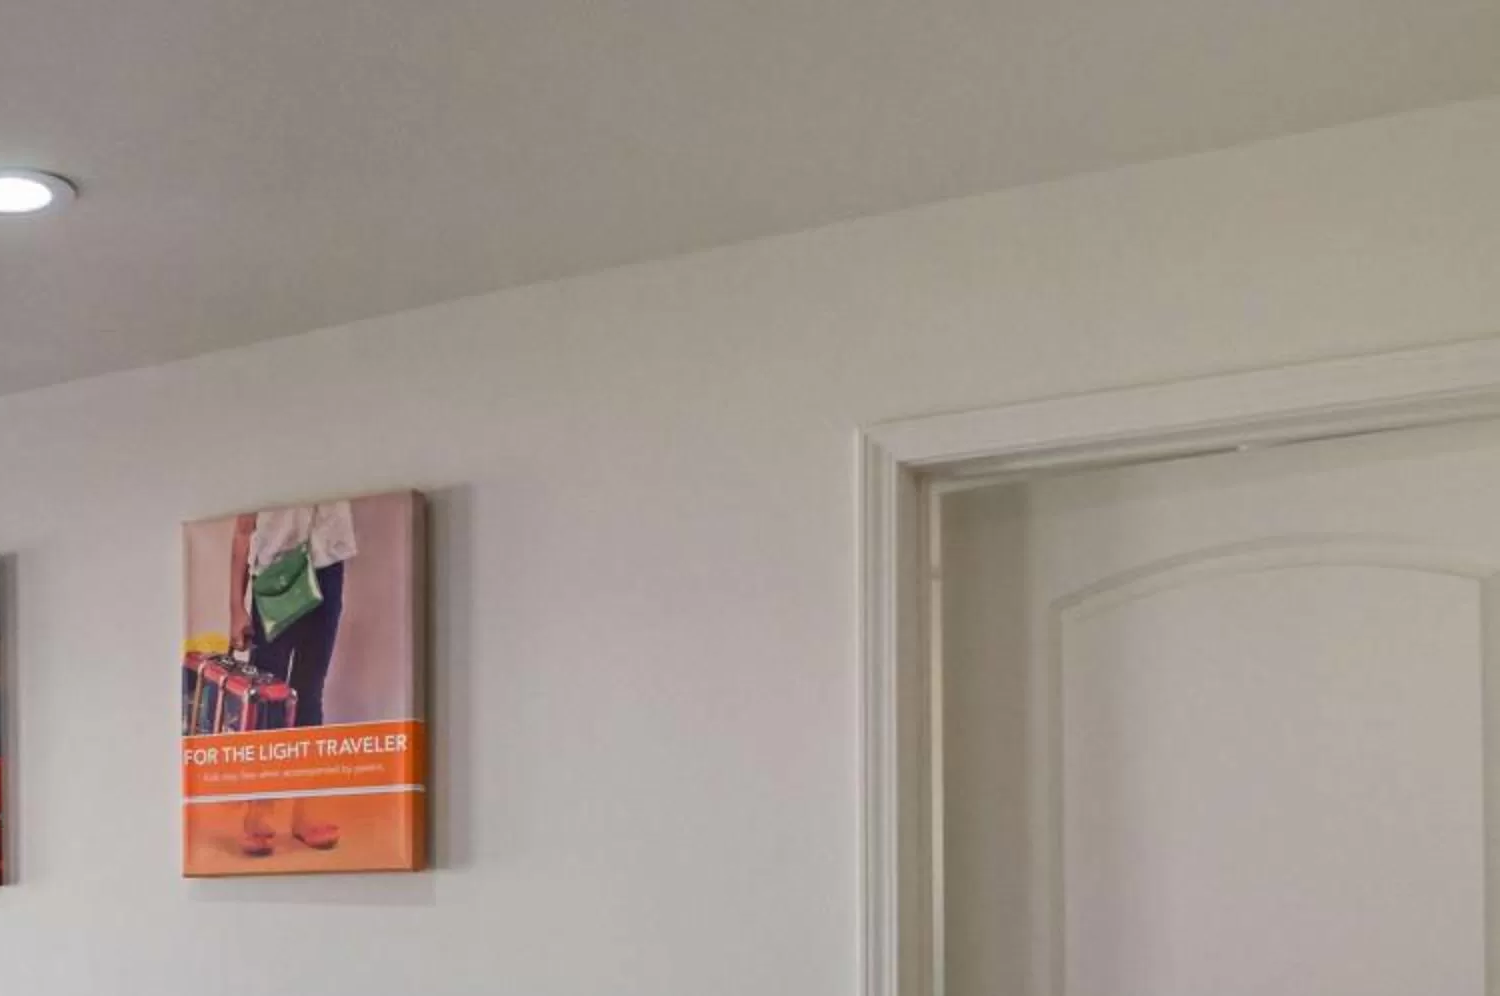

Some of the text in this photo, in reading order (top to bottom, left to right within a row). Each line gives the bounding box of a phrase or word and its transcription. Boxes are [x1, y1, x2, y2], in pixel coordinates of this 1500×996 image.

[184, 734, 407, 766] FOR THE LIGHT TRAVELER
